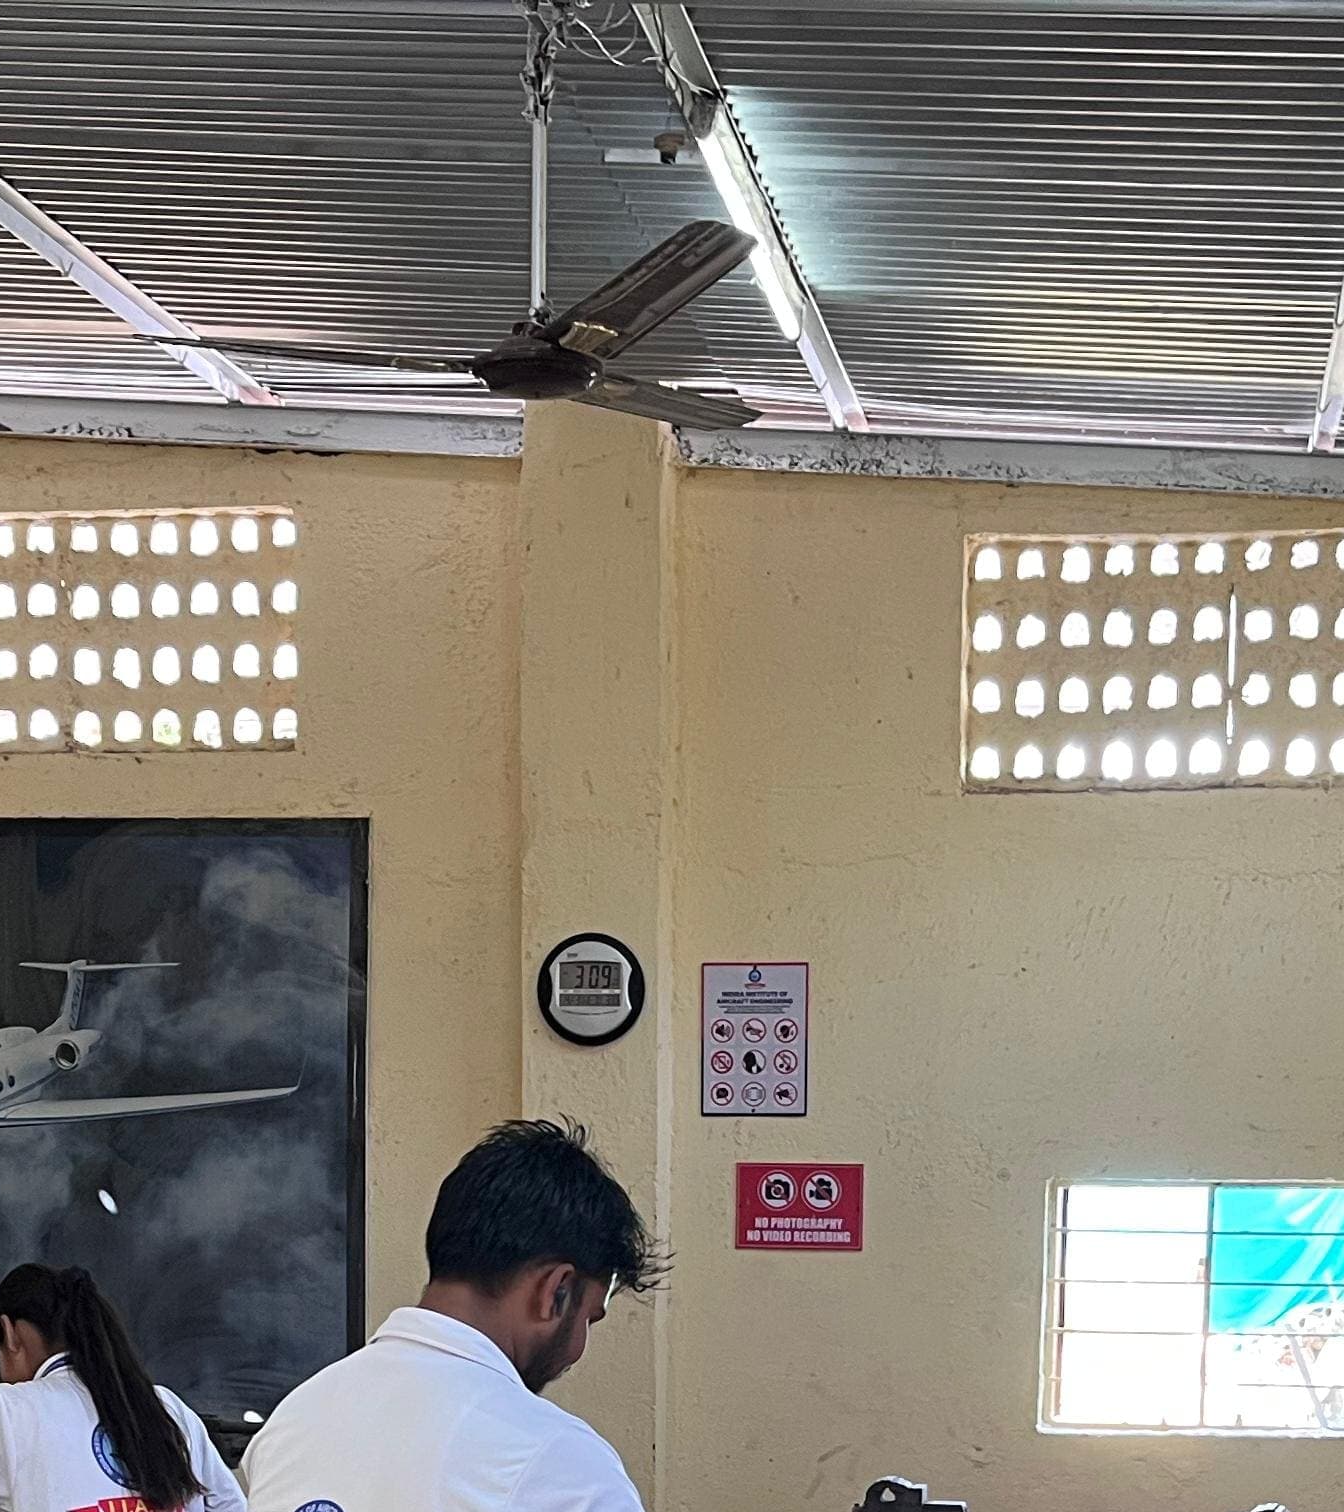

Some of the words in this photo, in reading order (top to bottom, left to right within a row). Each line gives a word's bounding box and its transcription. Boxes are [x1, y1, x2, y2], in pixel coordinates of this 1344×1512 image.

[755, 1217, 768, 1229] NO
[770, 1217, 843, 1230] PHOTOGRAPHY
[746, 1230, 761, 1241] NO
[762, 1230, 792, 1242] VIDEO
[793, 1231, 851, 1243] RECORDING
